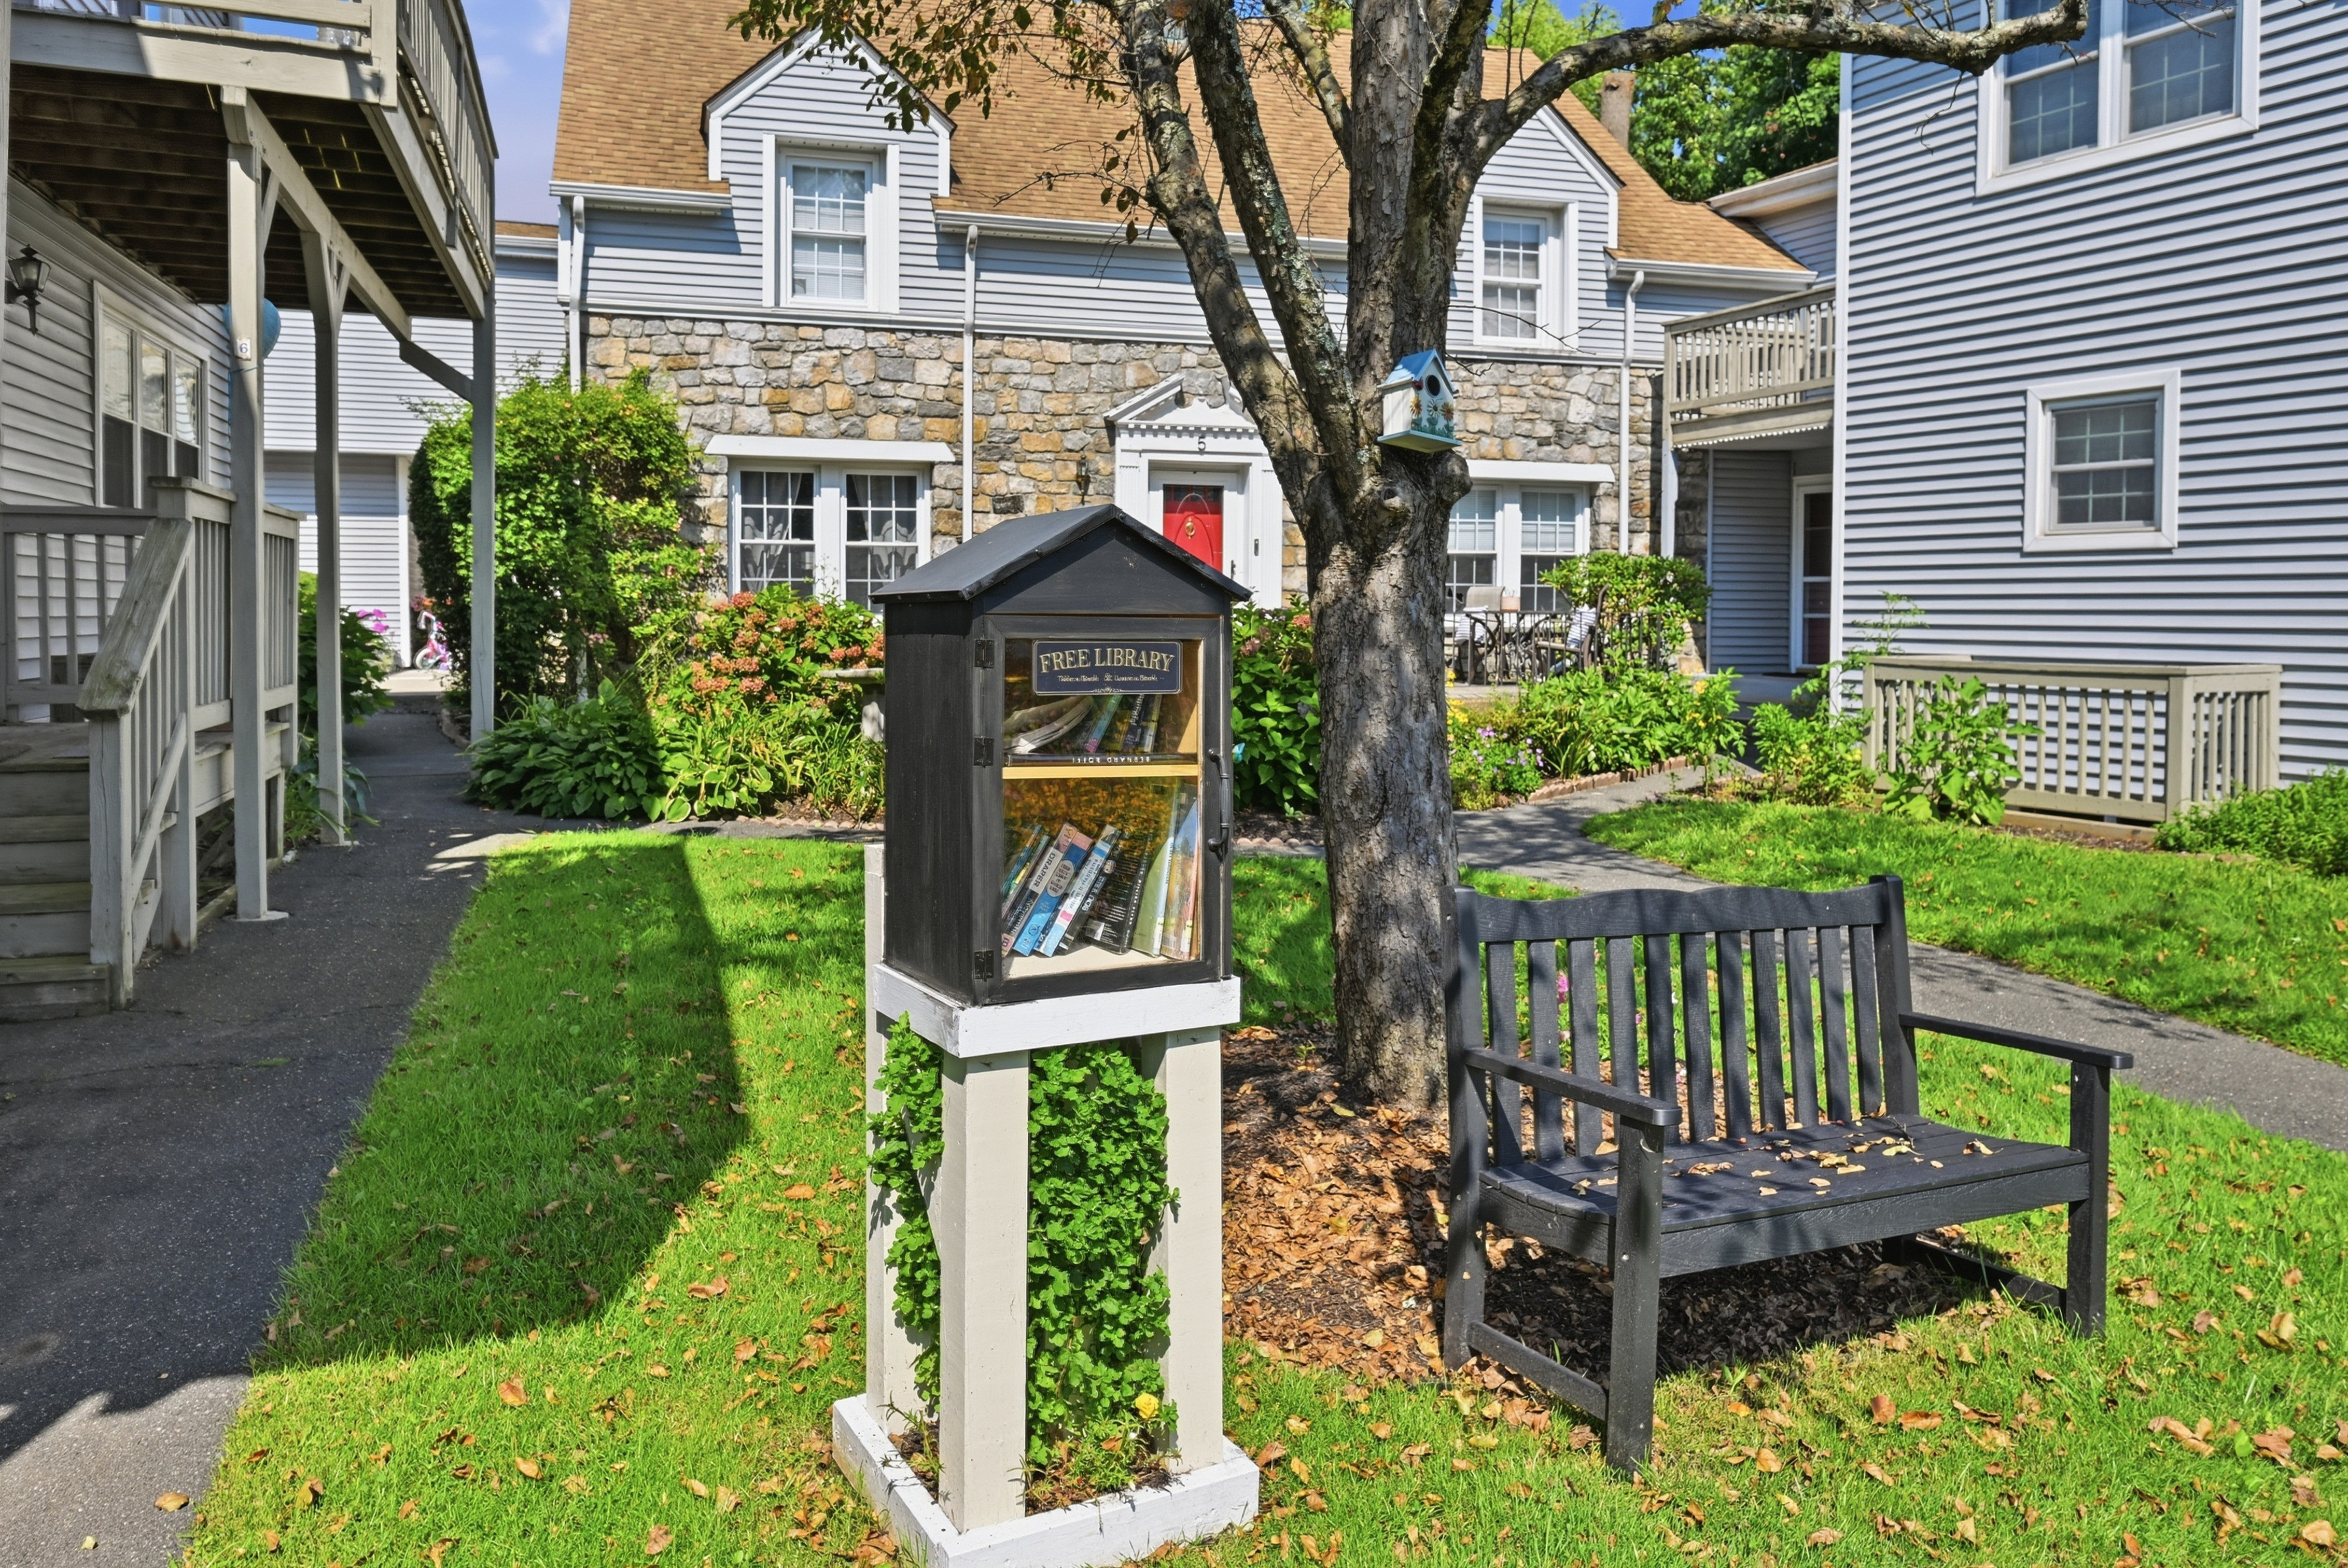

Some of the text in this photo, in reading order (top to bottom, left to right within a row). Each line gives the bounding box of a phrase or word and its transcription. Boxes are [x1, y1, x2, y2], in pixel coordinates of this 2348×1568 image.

[240, 342, 248, 354] 6
[1198, 436, 1206, 452] 5
[1039, 648, 1175, 673] FREE LIBRARY
[1033, 852, 1056, 888] DRAPER
